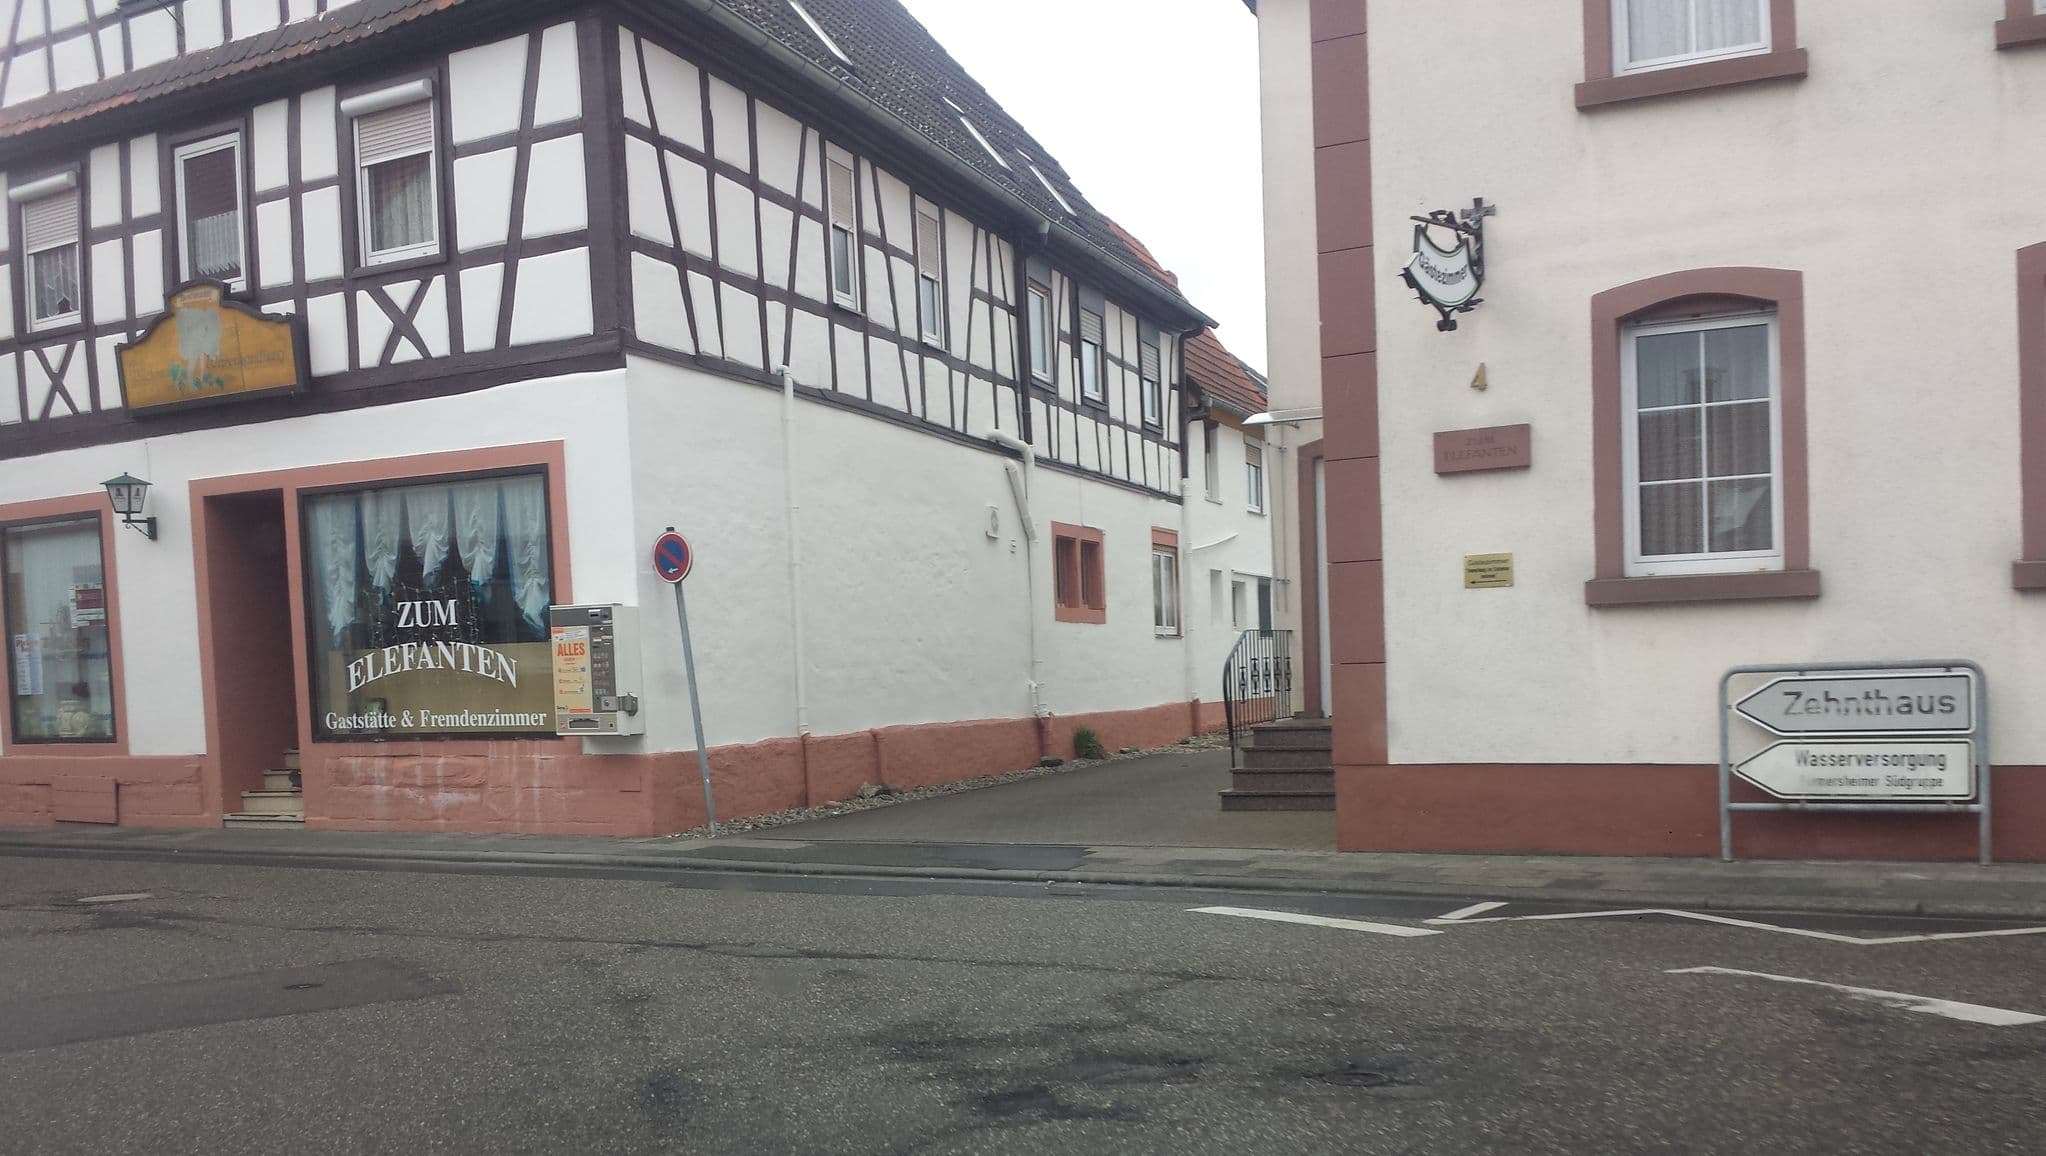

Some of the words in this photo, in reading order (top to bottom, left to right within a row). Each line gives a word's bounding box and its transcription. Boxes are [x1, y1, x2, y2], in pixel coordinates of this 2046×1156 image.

[1470, 362, 1488, 391] 4
[1443, 445, 1519, 461] ELEFANTEN
[397, 599, 457, 628] ZUM
[557, 642, 586, 657] ALLES
[347, 640, 518, 693] ELEFANTEN
[1783, 689, 1956, 716] Zehnthaus
[325, 710, 397, 730] Gaststätte
[401, 709, 414, 728] &
[420, 708, 547, 728] Fremdenzimmer
[1795, 749, 1947, 771] Wasserversorgung
